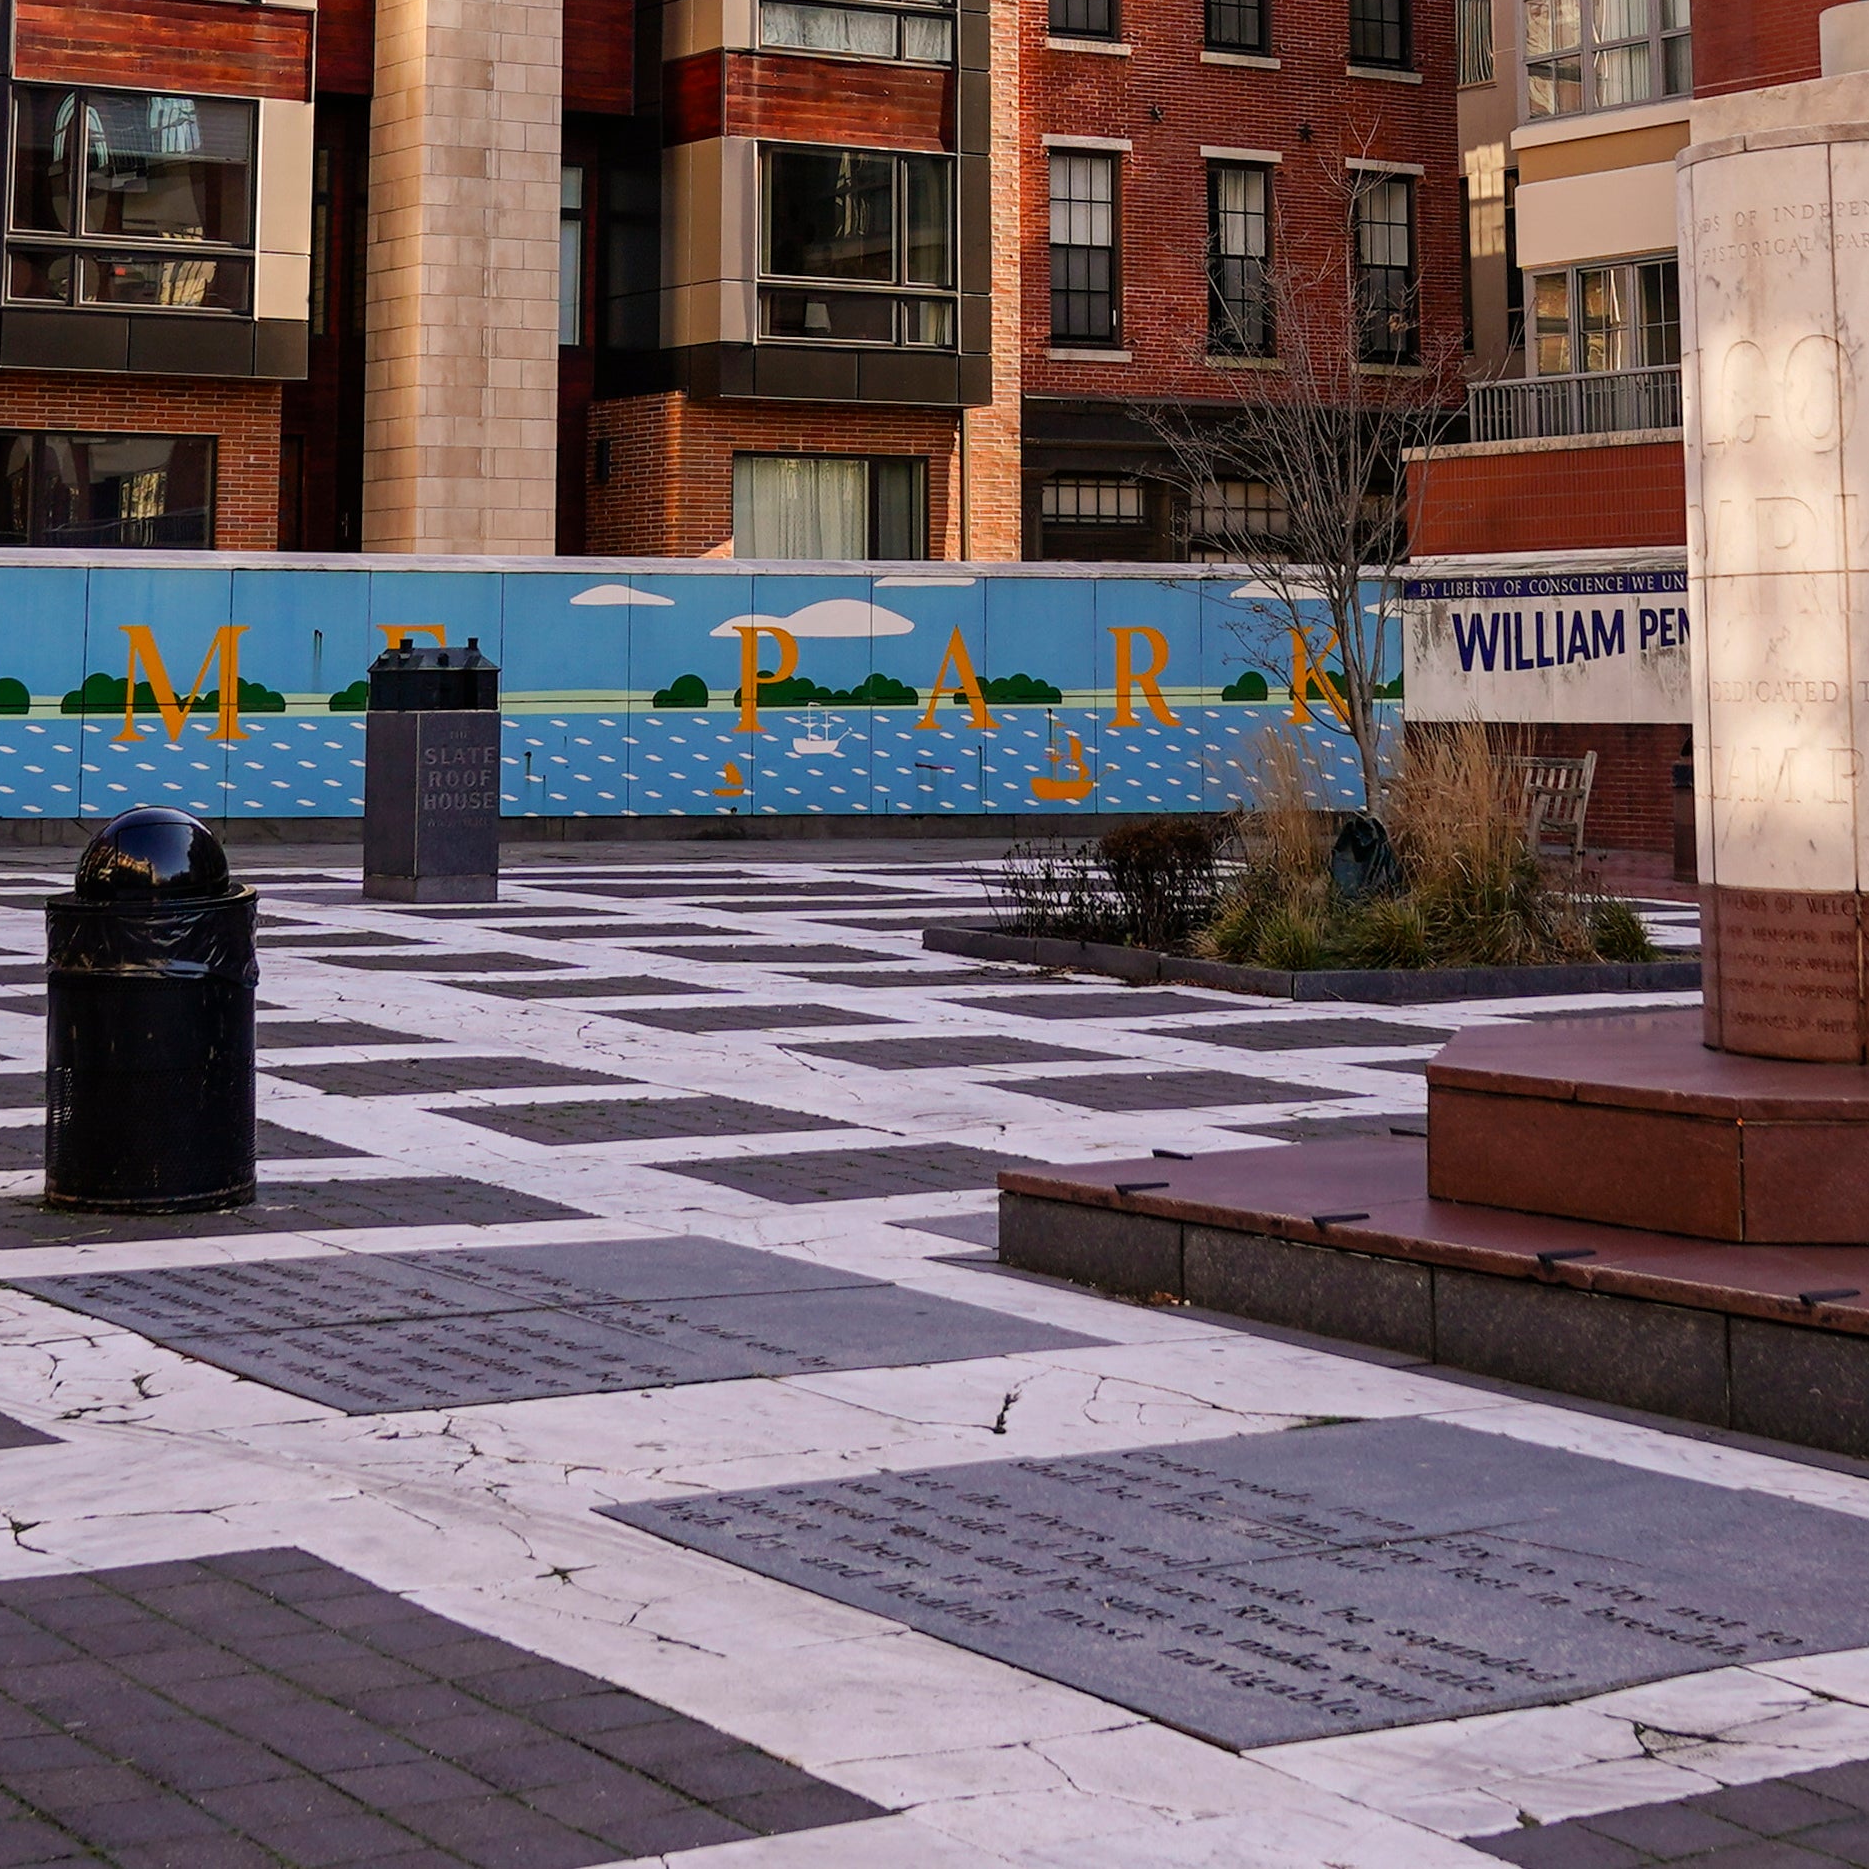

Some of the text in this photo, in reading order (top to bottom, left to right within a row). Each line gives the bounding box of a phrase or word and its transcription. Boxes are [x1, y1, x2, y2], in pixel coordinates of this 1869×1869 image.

[1735, 209, 1757, 228] OF
[1421, 582, 1437, 596] BY
[1443, 580, 1497, 597] LIBERTY
[1504, 579, 1522, 595] OF
[1529, 576, 1624, 595] CONSCIENCE
[1632, 575, 1654, 590] WE
[1452, 609, 1625, 672] WILLIAM
[1712, 680, 1839, 703] DEDICATED
[424, 746, 497, 765] SLATE
[428, 769, 492, 788] ROOF
[423, 791, 496, 811] HOUSE
